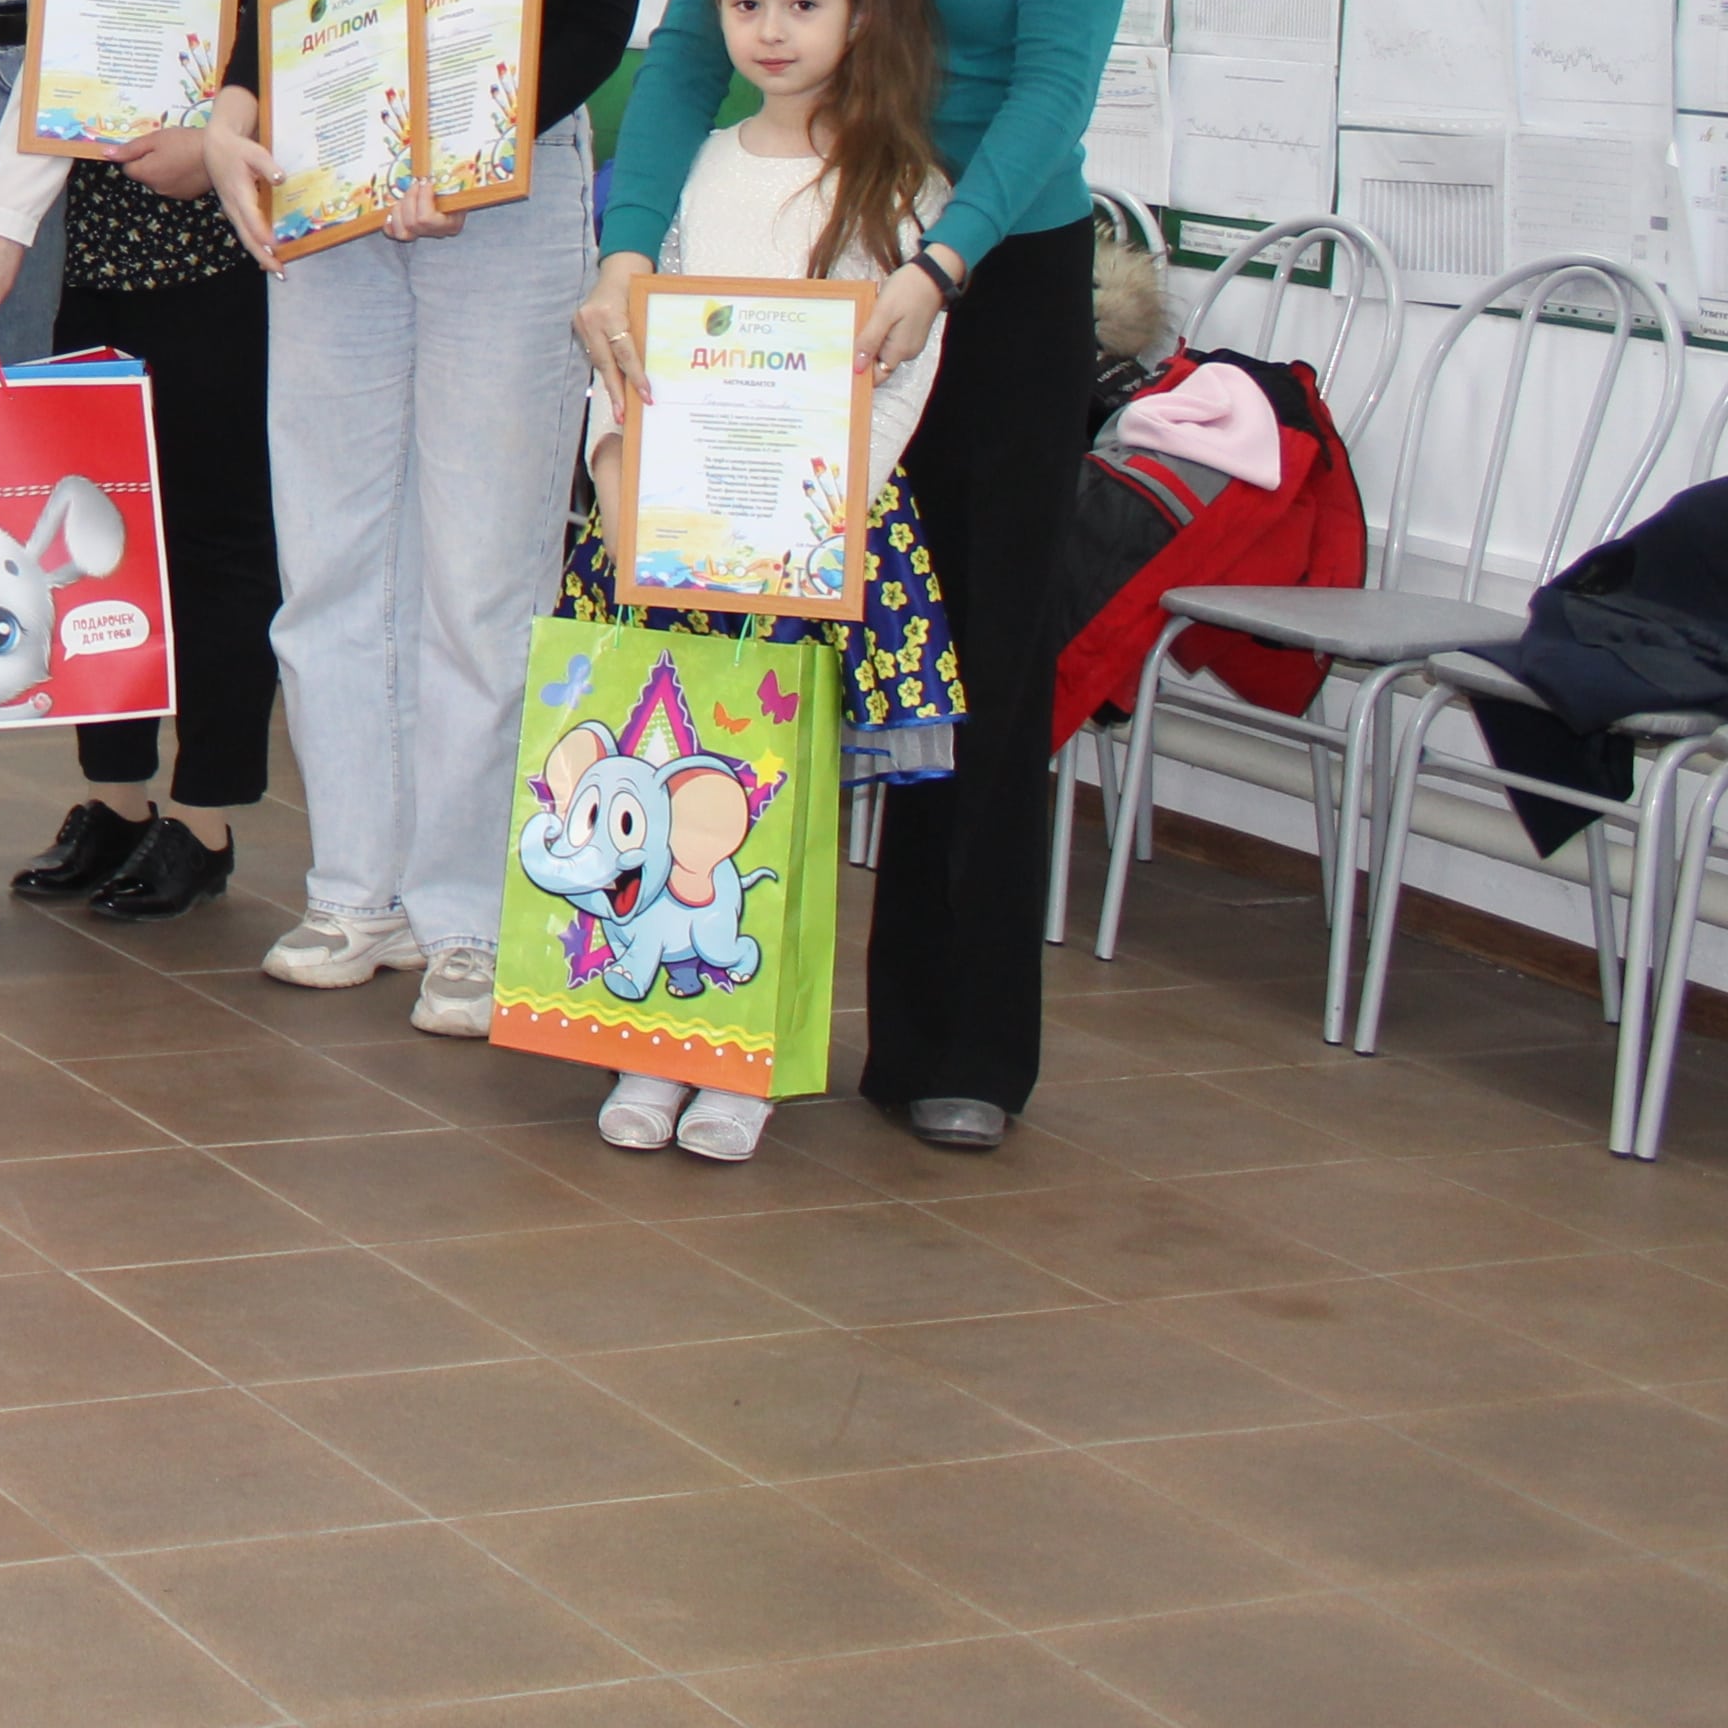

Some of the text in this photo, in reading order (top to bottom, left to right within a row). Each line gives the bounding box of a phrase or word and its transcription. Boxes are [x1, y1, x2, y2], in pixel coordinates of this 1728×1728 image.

[302, 8, 379, 55] ДИПЛОМ
[739, 309, 808, 324] ПРОГРЕСС
[739, 323, 773, 336] АГРО
[691, 347, 807, 372] ДИПЛОМ
[72, 613, 136, 631] ПОДАРОЧЕК
